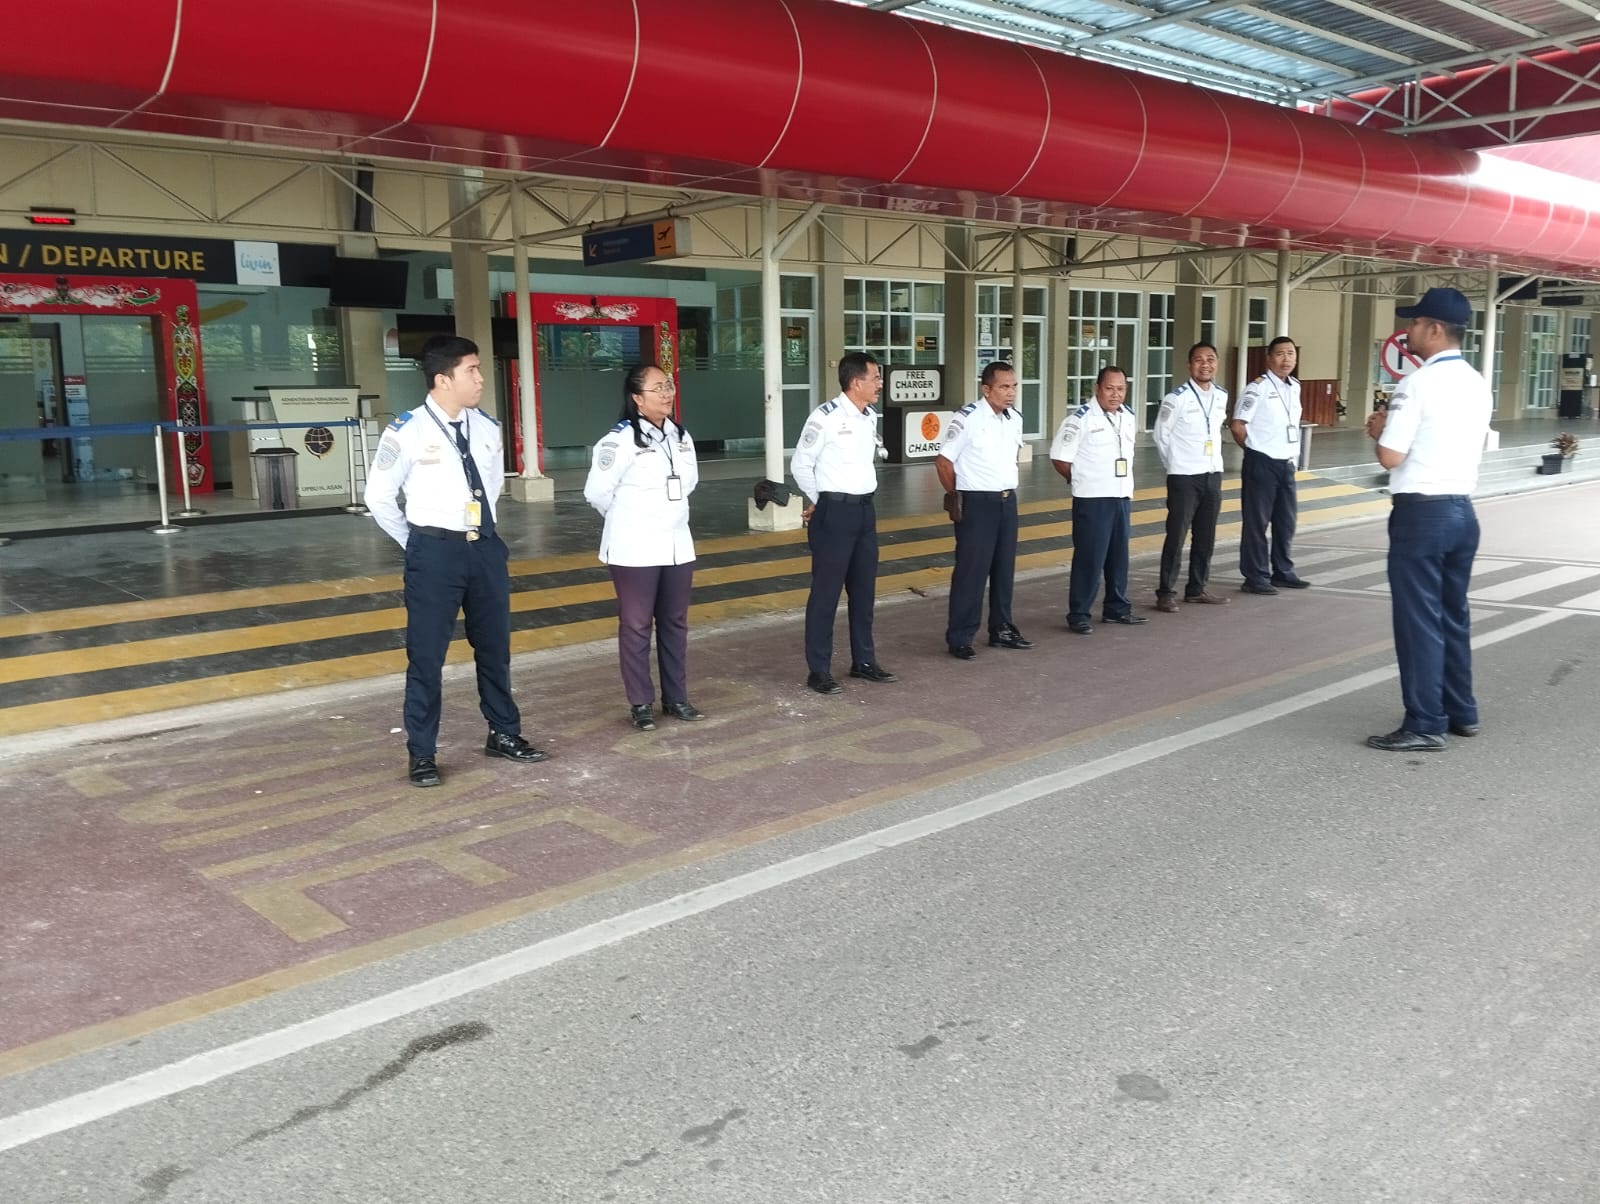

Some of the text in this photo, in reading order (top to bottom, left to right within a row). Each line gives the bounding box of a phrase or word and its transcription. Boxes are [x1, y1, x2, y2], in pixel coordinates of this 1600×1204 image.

[18, 244, 31, 268] /
[41, 244, 206, 272] DEPARTURE
[906, 371, 926, 379] FREE
[895, 380, 934, 389] CHARGER
